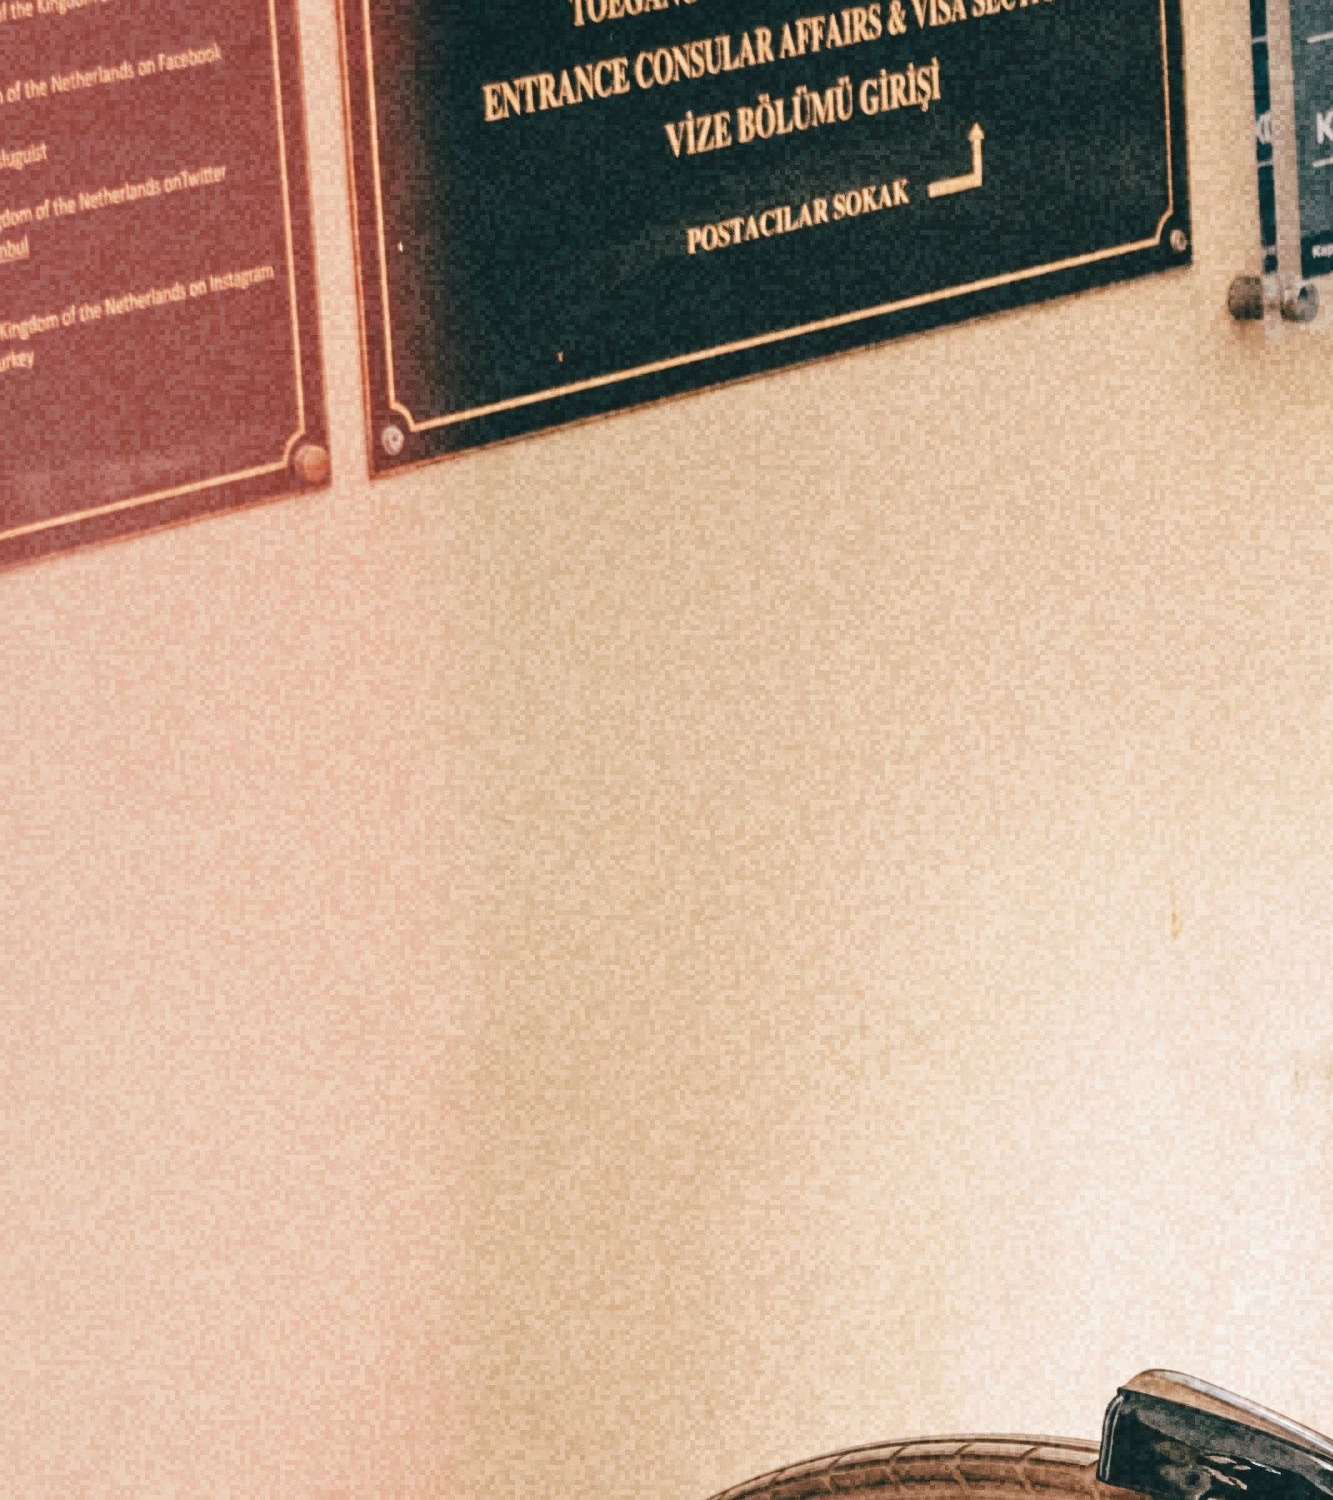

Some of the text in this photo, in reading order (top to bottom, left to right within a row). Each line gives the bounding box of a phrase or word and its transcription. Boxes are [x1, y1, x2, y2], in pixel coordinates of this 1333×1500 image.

[10, 2, 34, 20] the
[7, 41, 223, 104] of the Netherlands on Facebook
[481, 55, 632, 124] ENTRANCE
[633, 25, 776, 91] CONSULAR
[779, 2, 884, 60] AFFAIRS
[663, 55, 943, 160] VİZE BÖLÜMÜ GİRİŞİ
[35, 199, 51, 222] of
[53, 195, 78, 218] the
[79, 177, 163, 211] Netherlands
[686, 177, 911, 256] POSTACILAR SOKAK
[61, 302, 77, 328] of
[79, 301, 102, 323] the
[104, 281, 188, 317] Netherlands
[189, 279, 208, 298] on
[209, 264, 275, 293] Instagram
